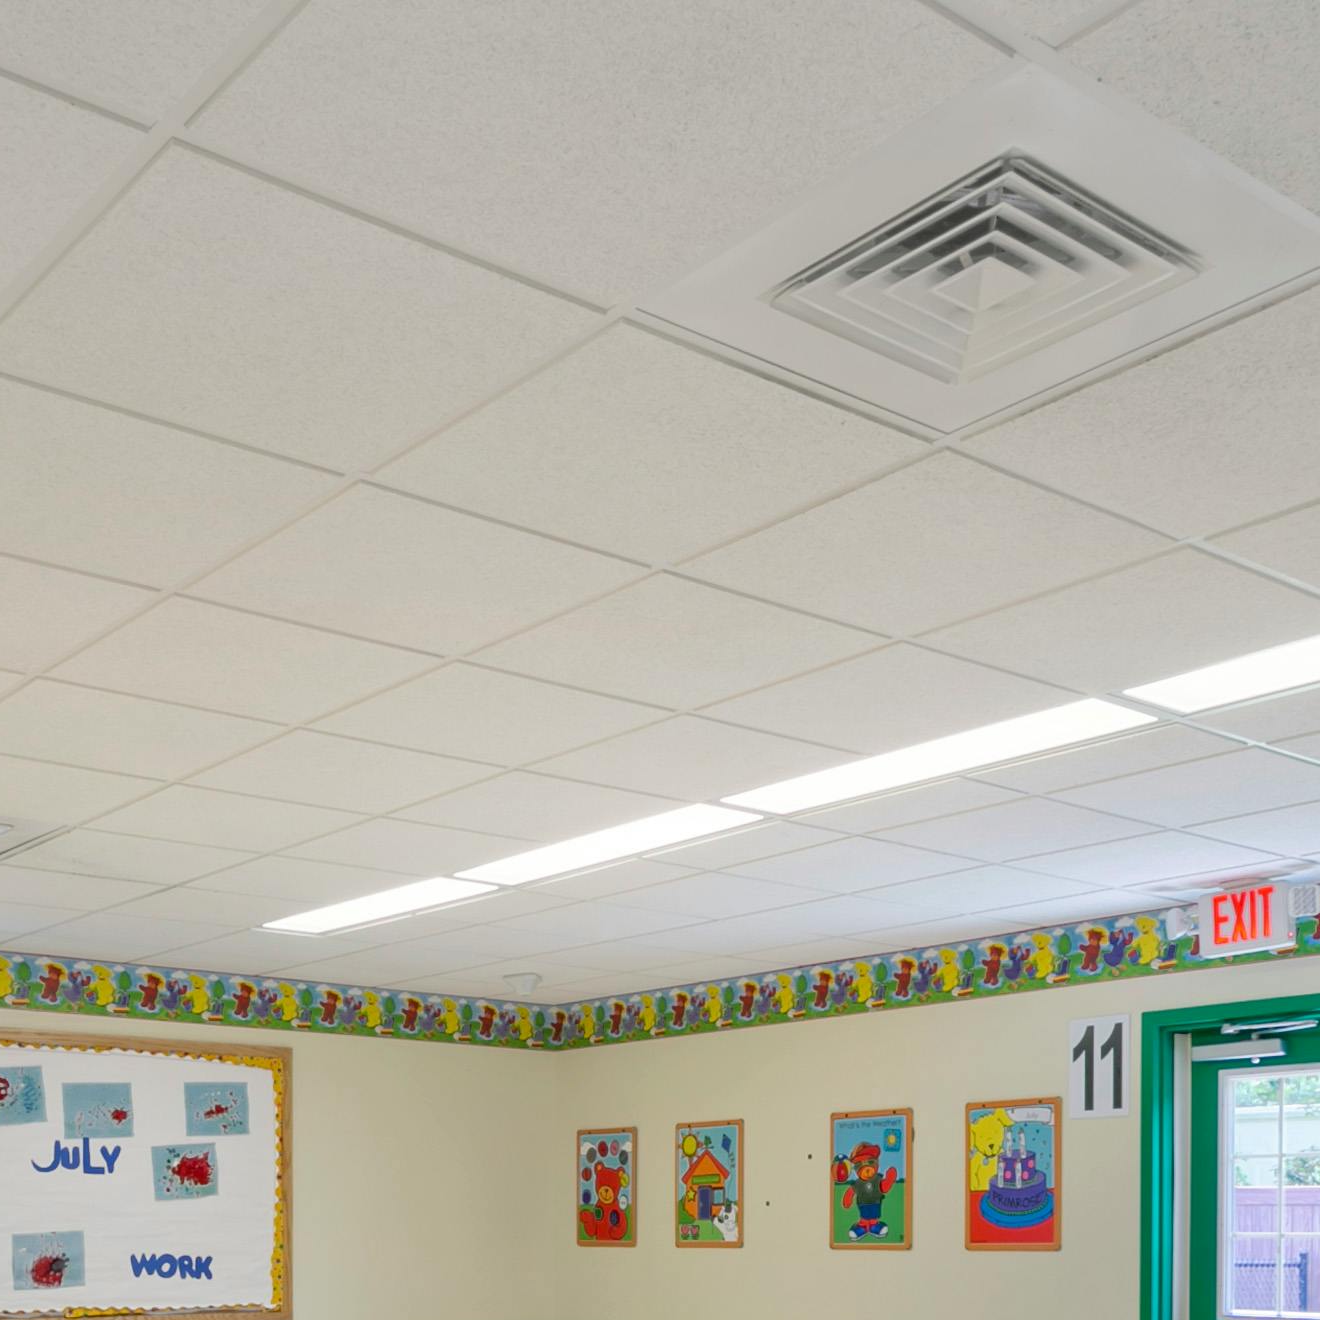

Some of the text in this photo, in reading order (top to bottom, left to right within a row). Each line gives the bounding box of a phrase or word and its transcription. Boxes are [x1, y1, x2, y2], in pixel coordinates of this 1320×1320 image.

[1212, 886, 1275, 945] EXIT
[1071, 1022, 1124, 1111] 11
[992, 1190, 1043, 1208] PRIMROSE
[130, 1253, 213, 1280] WORK
